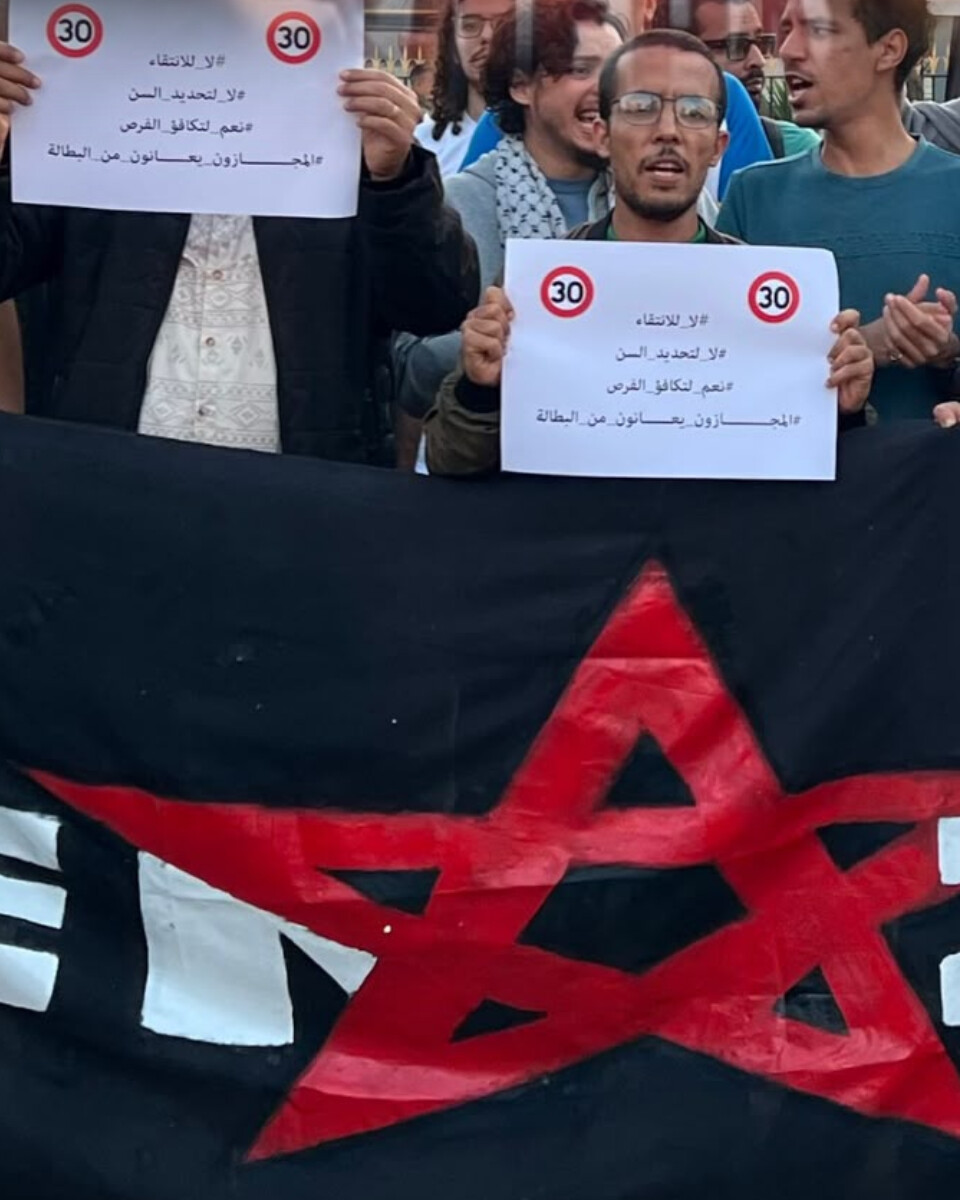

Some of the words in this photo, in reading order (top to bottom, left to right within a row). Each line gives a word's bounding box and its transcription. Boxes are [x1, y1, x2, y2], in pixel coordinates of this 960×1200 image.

[58, 19, 92, 43] 30
[277, 26, 311, 50] 30
[551, 281, 584, 304] 30
[758, 286, 790, 309] 30
